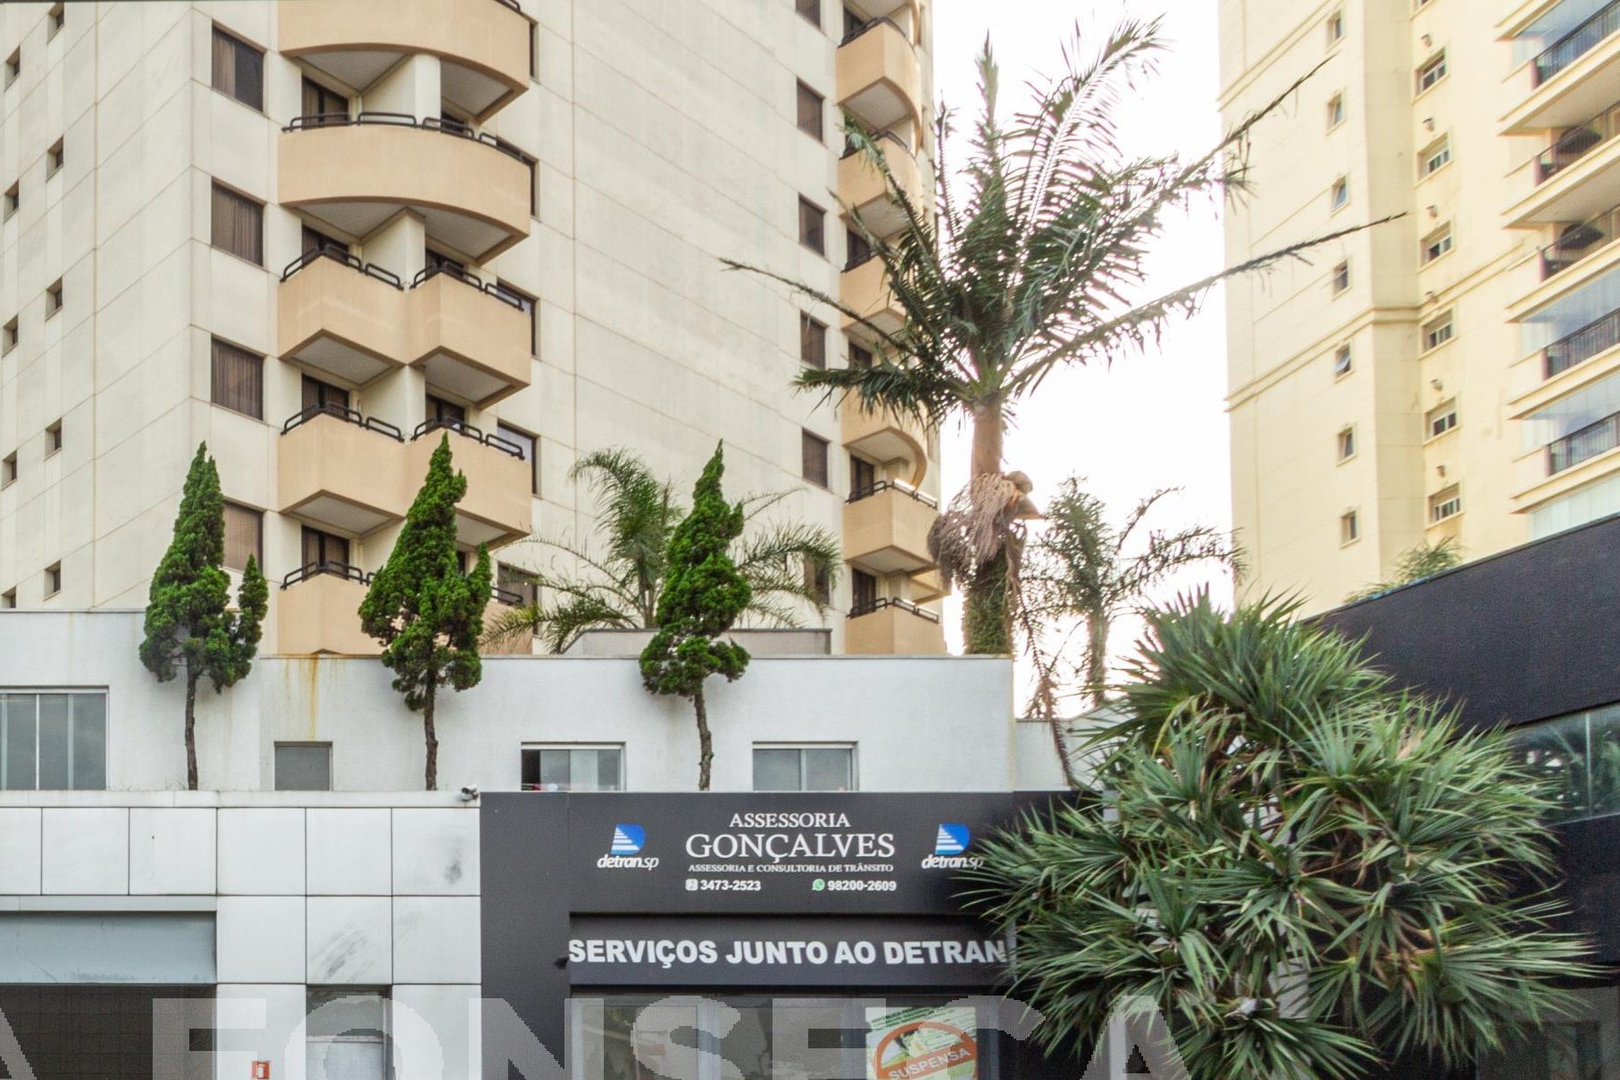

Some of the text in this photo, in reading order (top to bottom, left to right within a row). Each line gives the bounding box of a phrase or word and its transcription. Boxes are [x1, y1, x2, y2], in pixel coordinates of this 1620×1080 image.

[729, 812, 851, 828] ASSESSORIA
[685, 833, 896, 864] GONÇALVES
[688, 863, 894, 873] ASSESSORIA E CONSULTORIA DE TRÂNSITO
[700, 879, 762, 892] 3473-2523
[827, 880, 897, 892] 98200-2609
[568, 939, 1007, 969] SERVIÇOS JUNTO AO DETRAN
[888, 1047, 972, 1080] SUSPENSA
